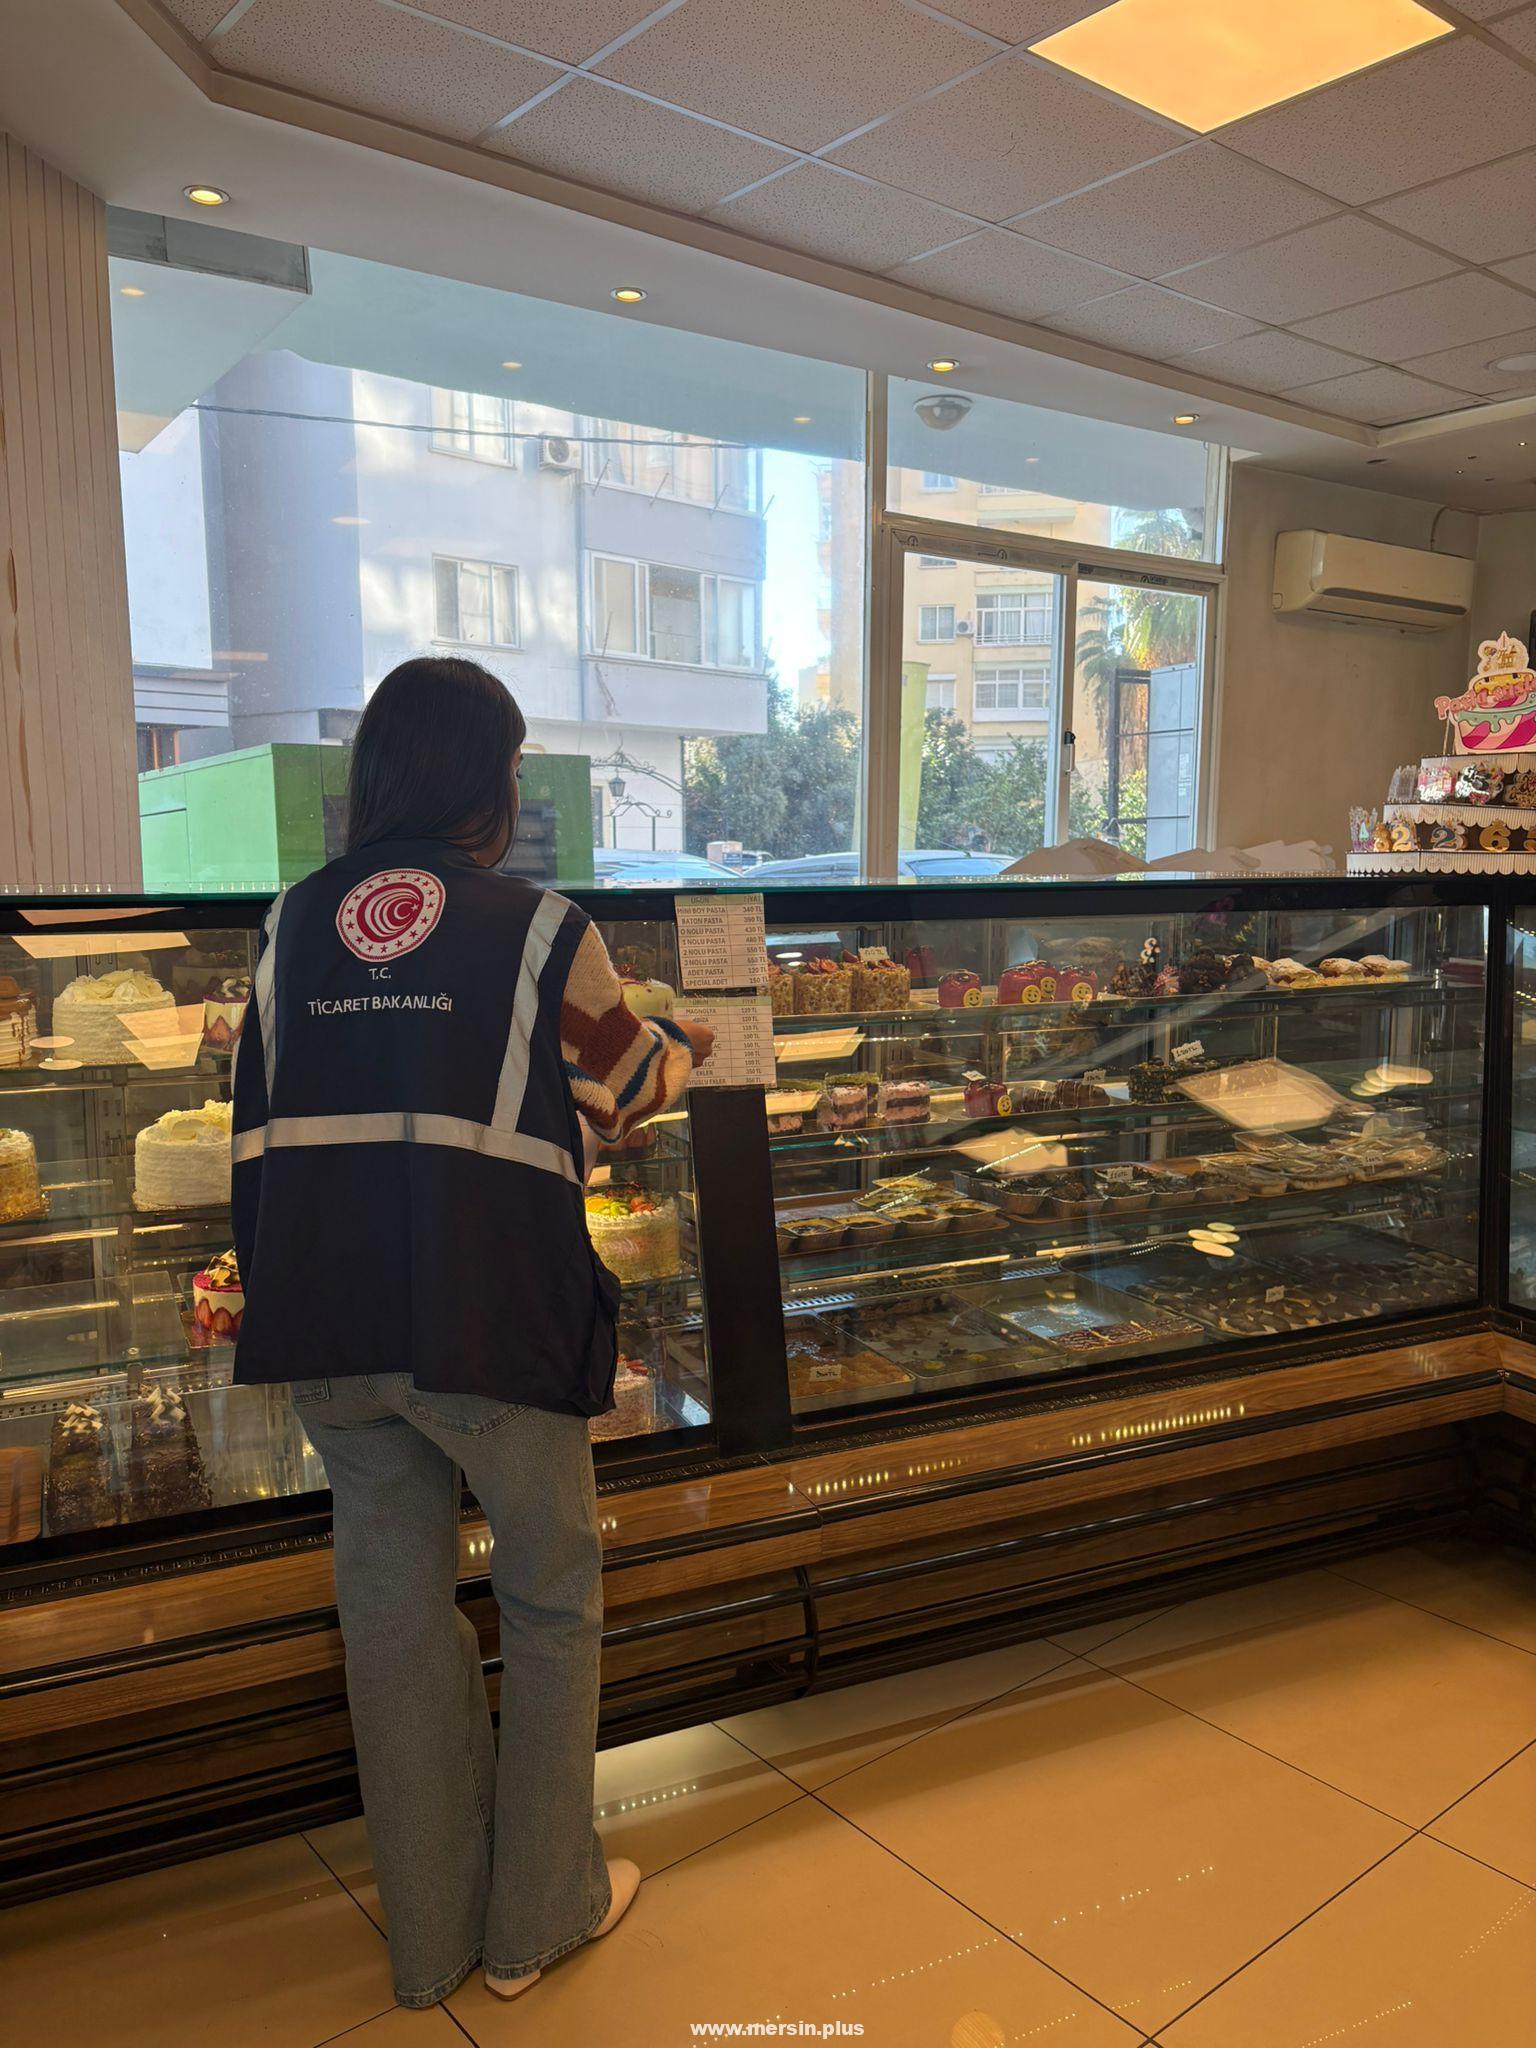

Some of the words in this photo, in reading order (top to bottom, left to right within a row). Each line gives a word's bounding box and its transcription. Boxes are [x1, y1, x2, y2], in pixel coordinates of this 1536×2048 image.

[368, 967, 392, 979] T.C.
[308, 997, 370, 1015] TİCARET
[372, 992, 452, 1011] BAKANLIĞI
